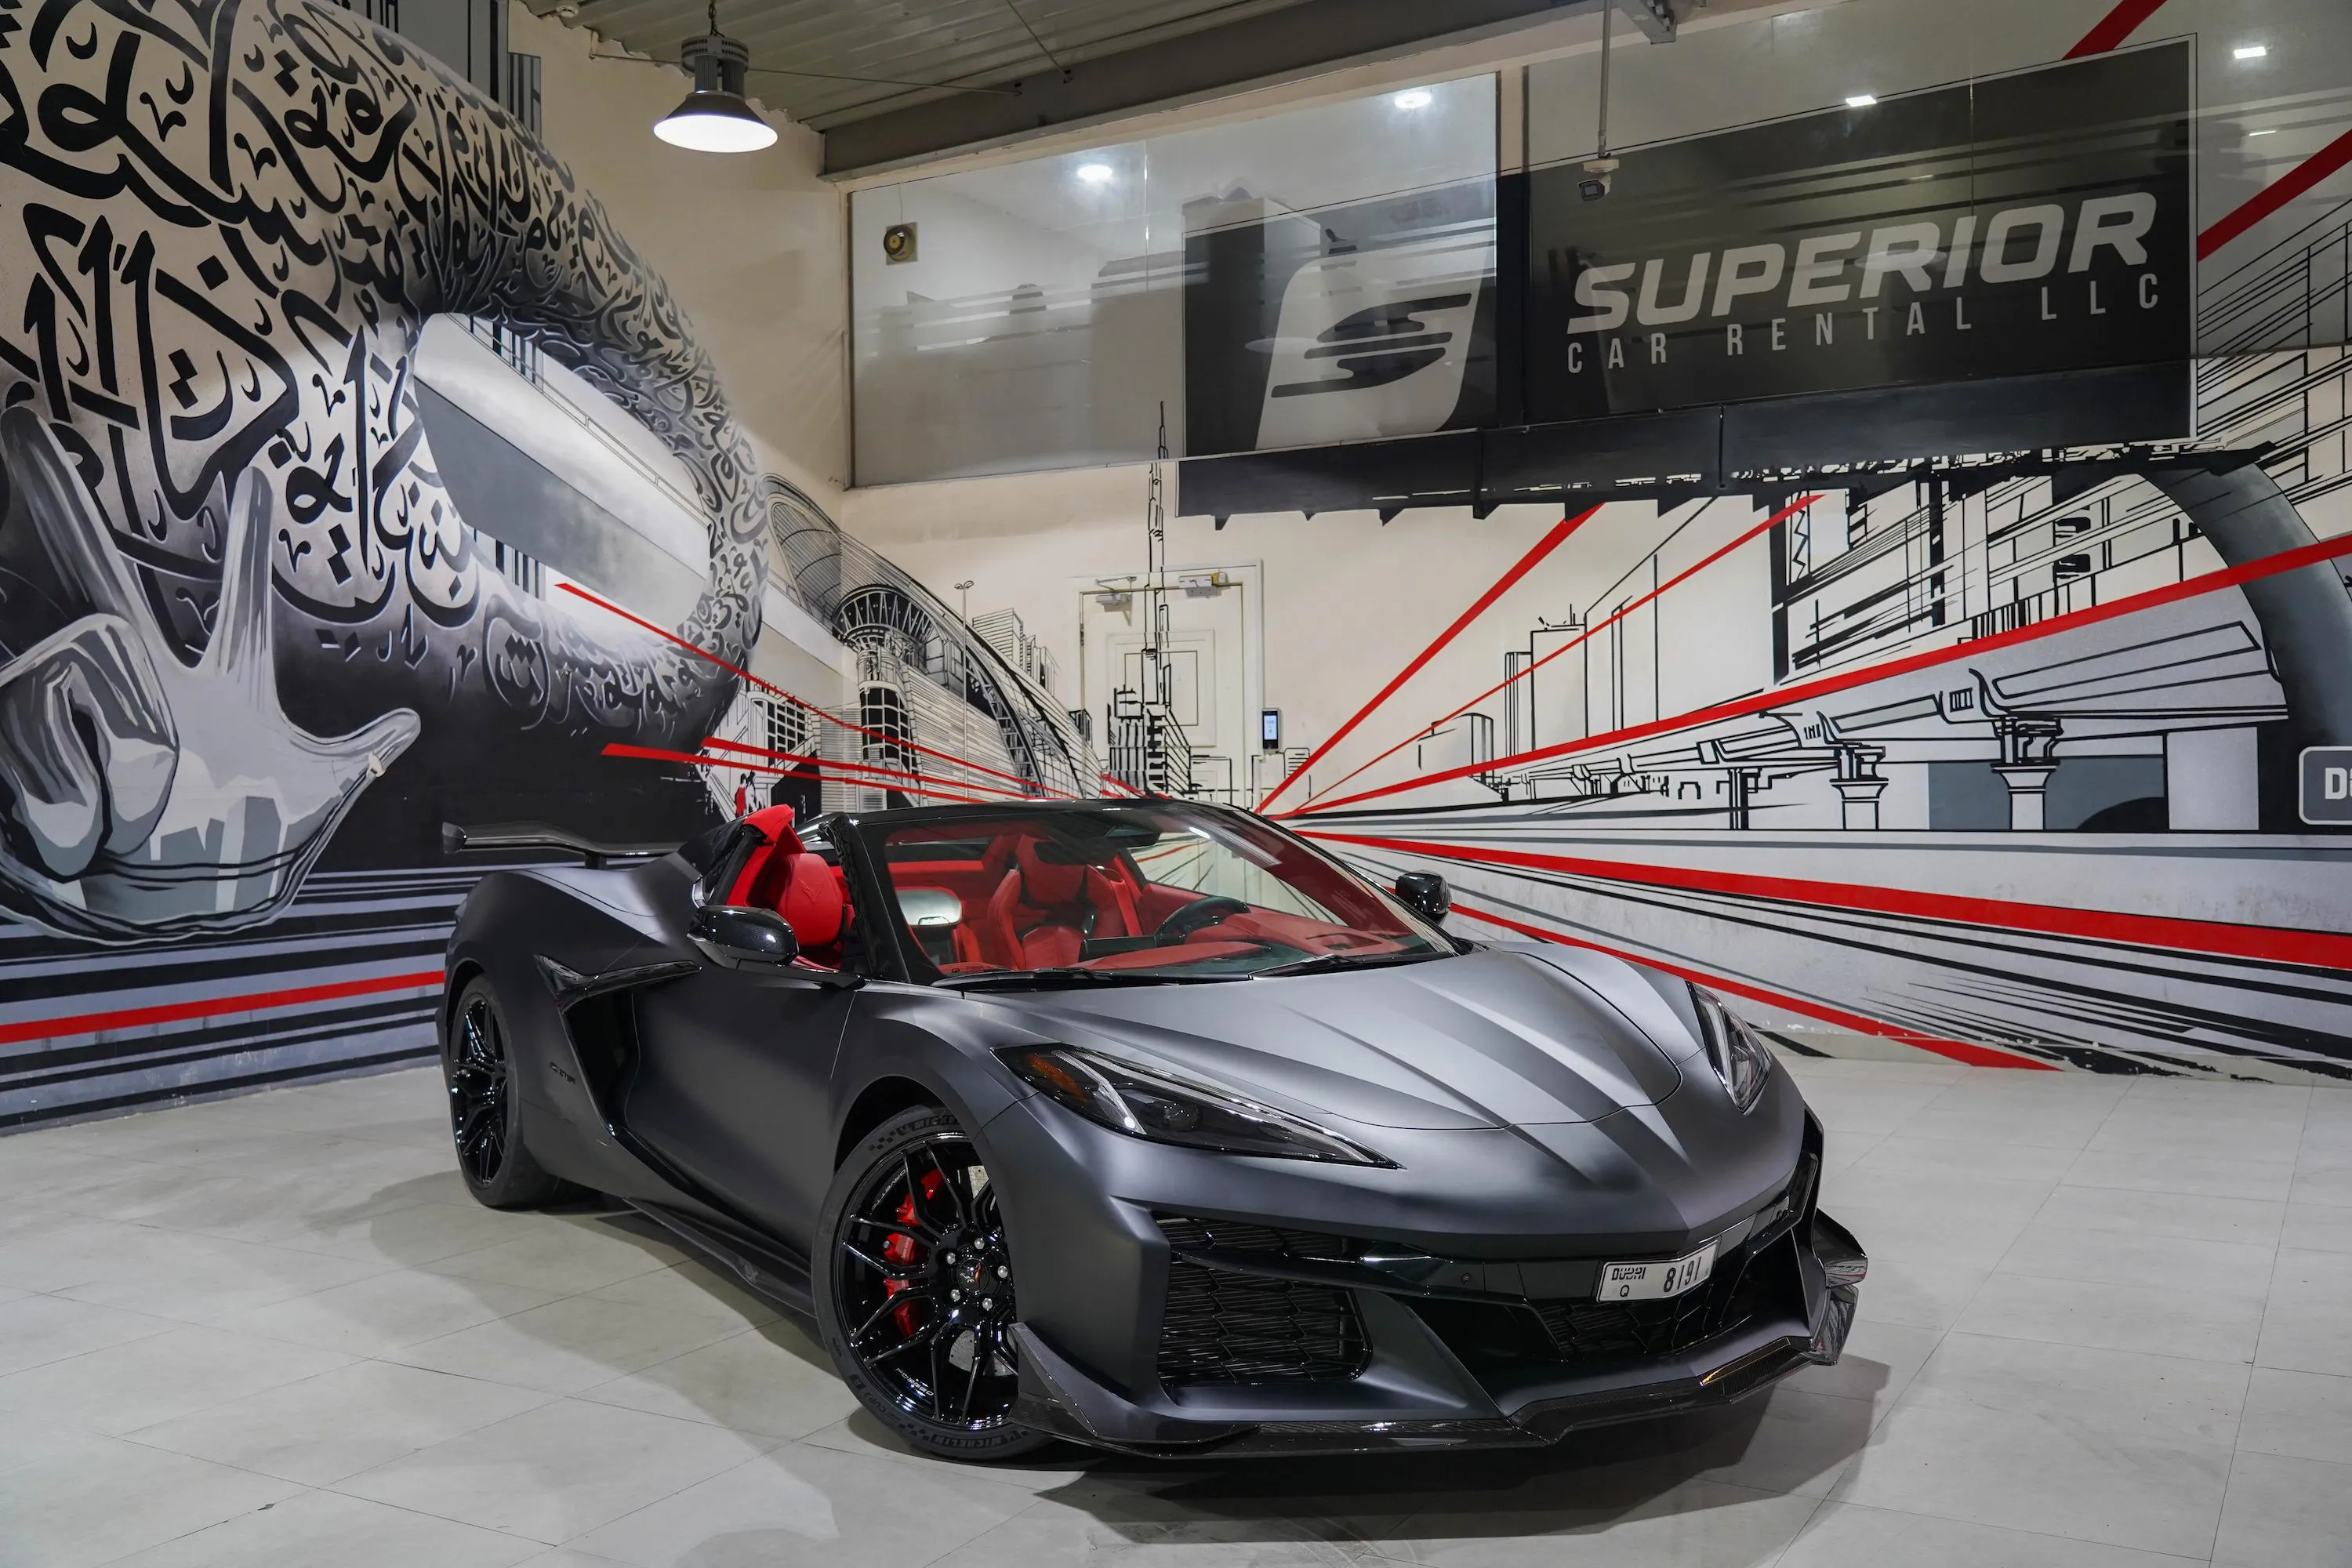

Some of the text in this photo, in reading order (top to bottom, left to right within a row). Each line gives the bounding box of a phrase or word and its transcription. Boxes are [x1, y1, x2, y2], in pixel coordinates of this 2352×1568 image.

[1566, 191, 2158, 335] SUPERIOR
[1568, 272, 2158, 374] CAR RENTAL LLC
[2325, 767, 2352, 800] D
[1620, 1284, 1630, 1298] Q
[1663, 1256, 1702, 1293] 8191
[934, 1434, 1003, 1448] MICHELIN
